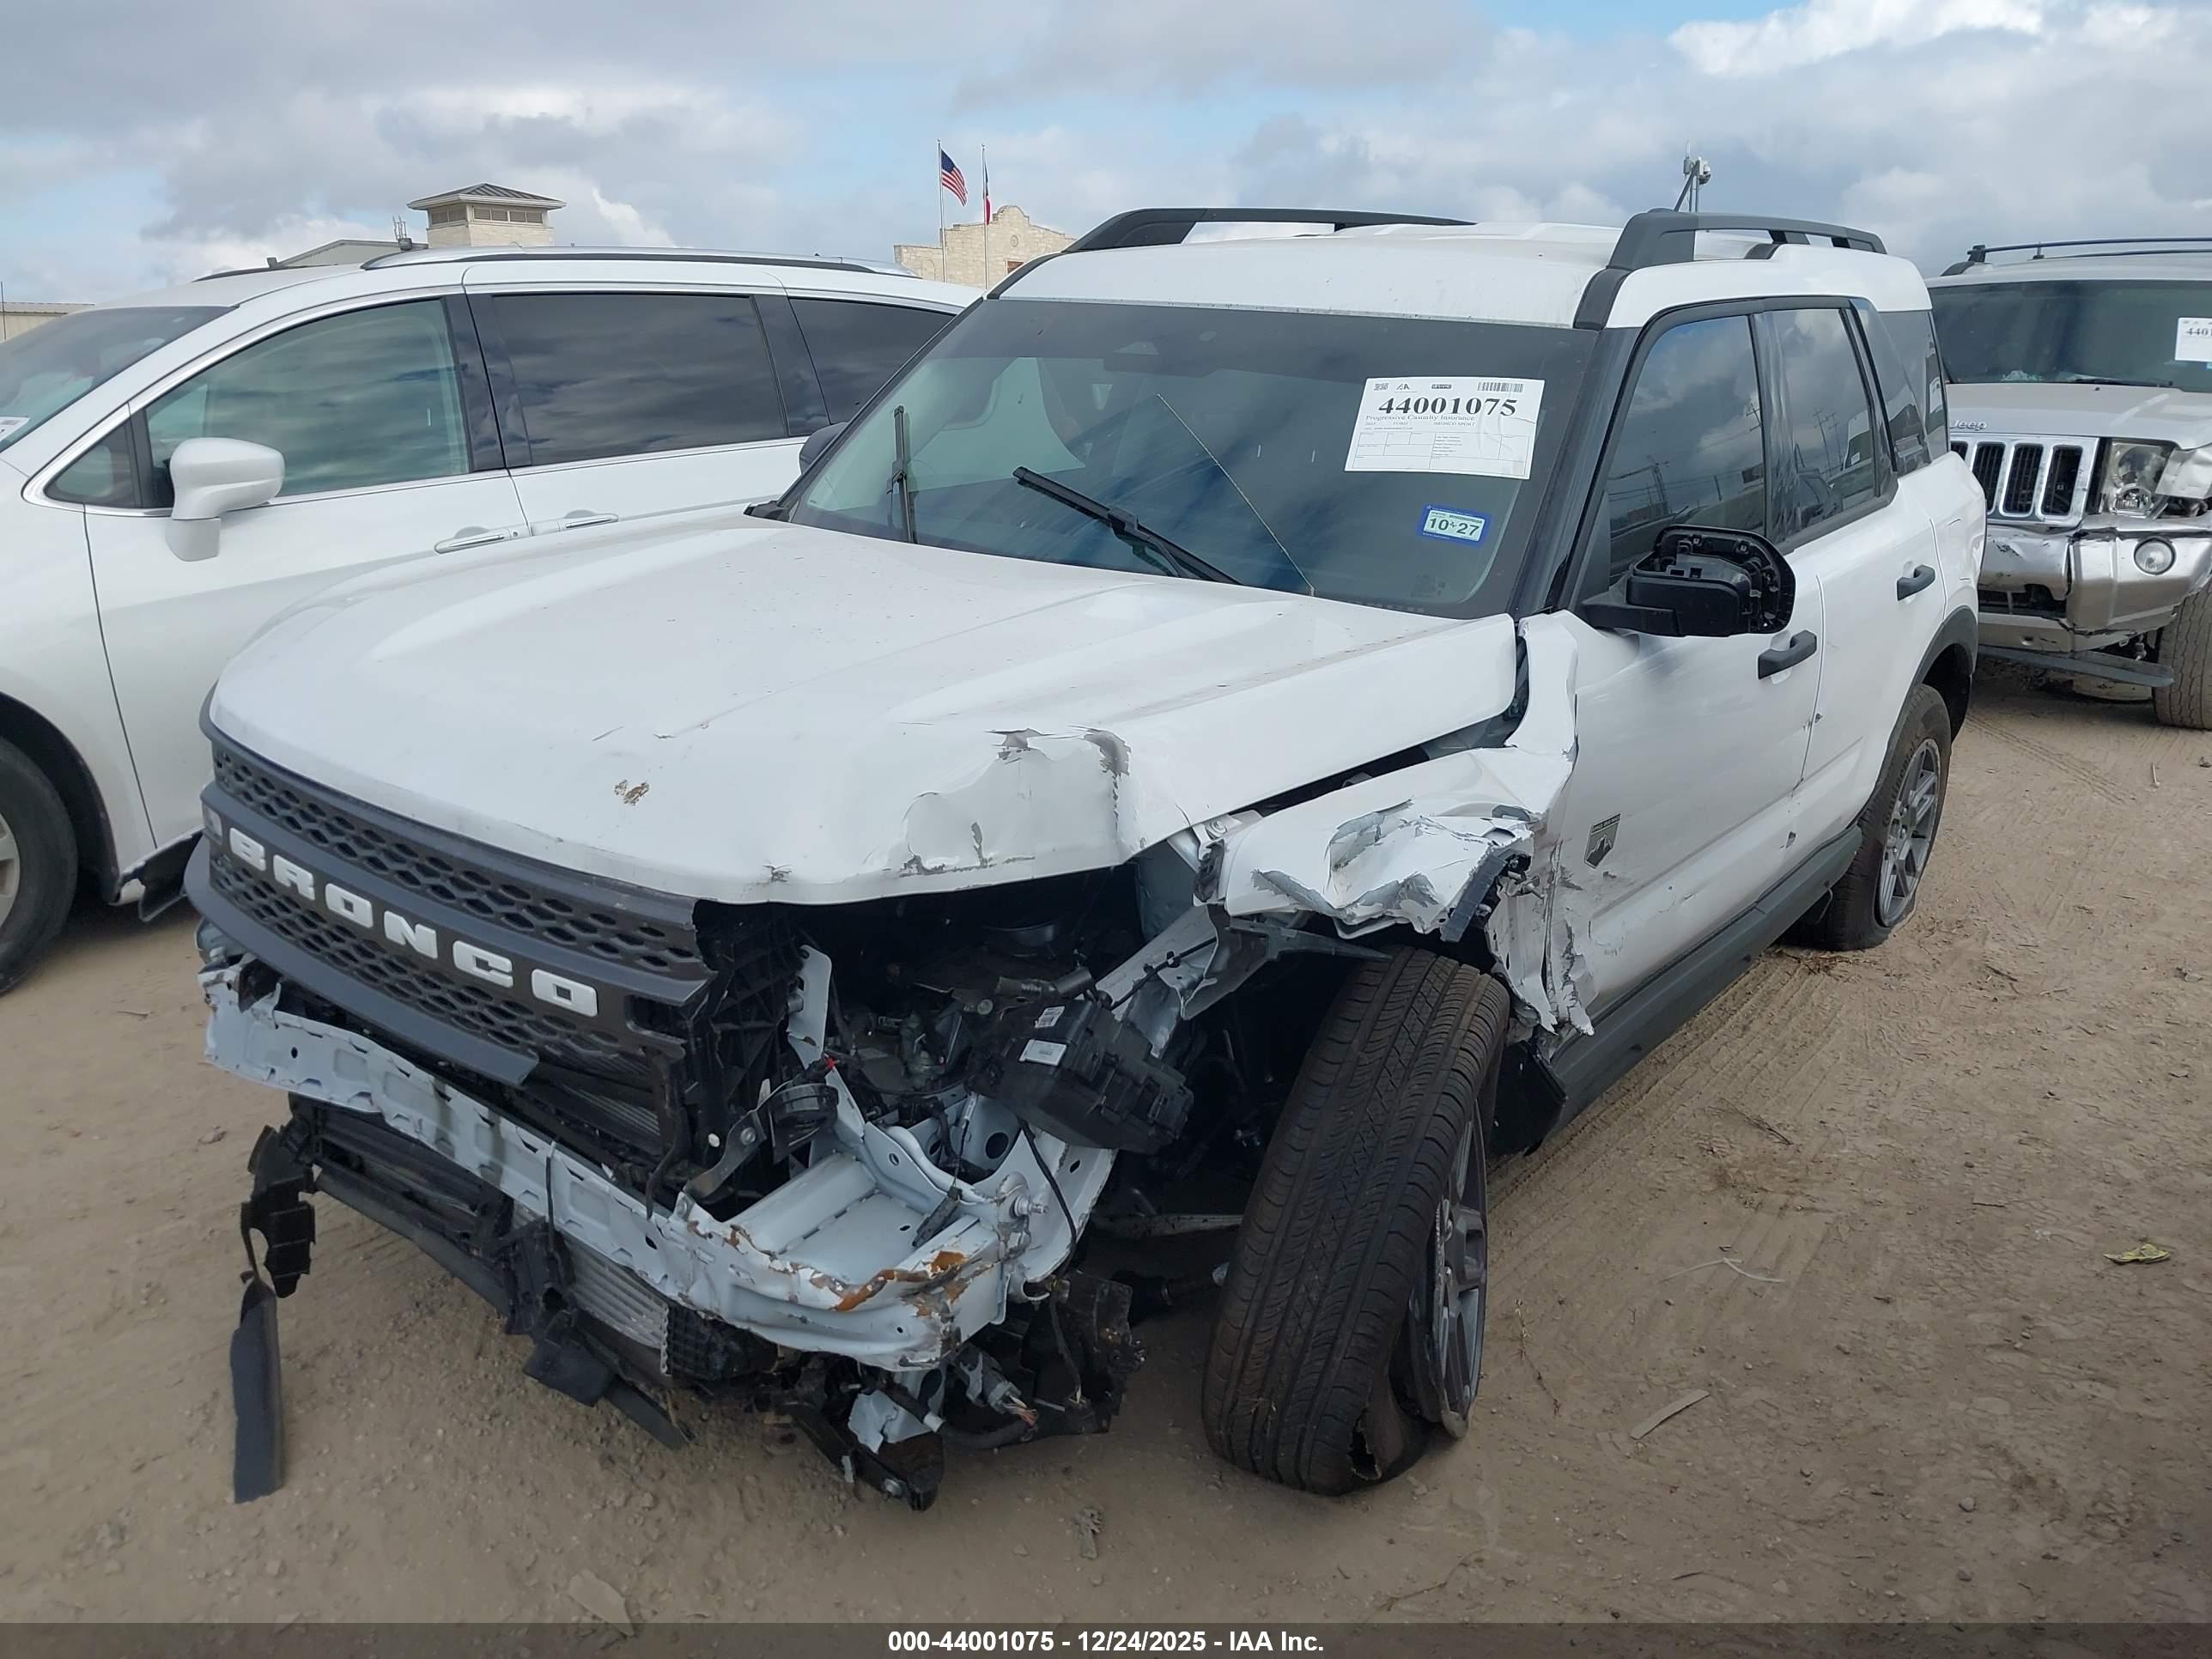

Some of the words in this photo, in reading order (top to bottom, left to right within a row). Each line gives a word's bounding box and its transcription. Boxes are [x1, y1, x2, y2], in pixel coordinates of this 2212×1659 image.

[1378, 397, 1517, 416] 44001075
[1950, 419, 1988, 431] Jeep
[1430, 518, 1449, 531] 10
[1455, 522, 1480, 536] 27
[228, 827, 599, 1018] BRONCO
